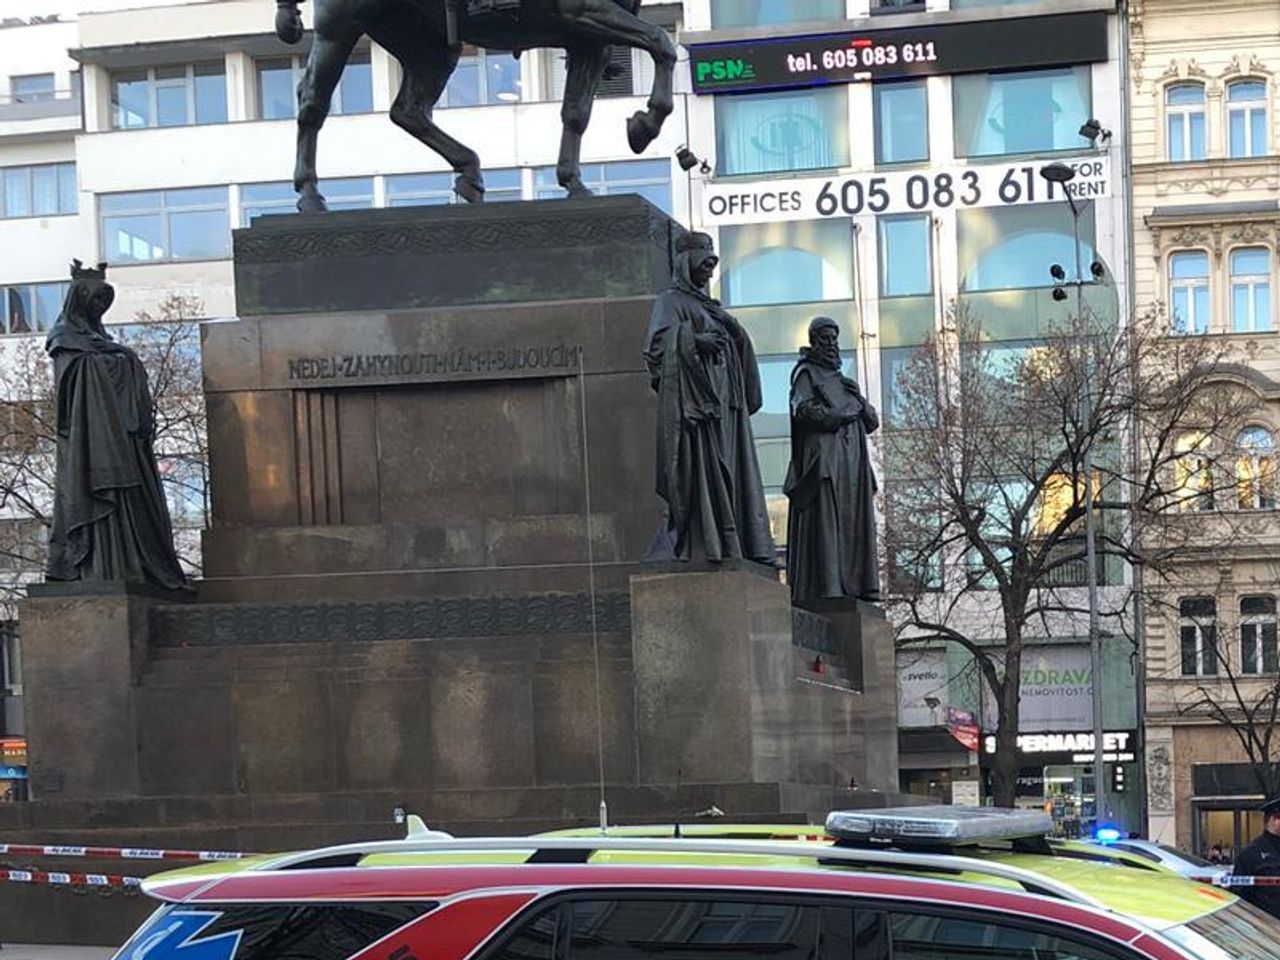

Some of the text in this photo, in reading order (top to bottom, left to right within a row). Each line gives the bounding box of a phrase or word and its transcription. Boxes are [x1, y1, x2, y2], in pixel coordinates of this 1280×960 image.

[786, 42, 937, 73] tel. 605 083 611
[1070, 161, 1103, 178] FOR
[709, 190, 802, 217] OFFICES
[815, 177, 890, 216] 605
[906, 171, 981, 210] 083
[1068, 180, 1107, 197] RENT
